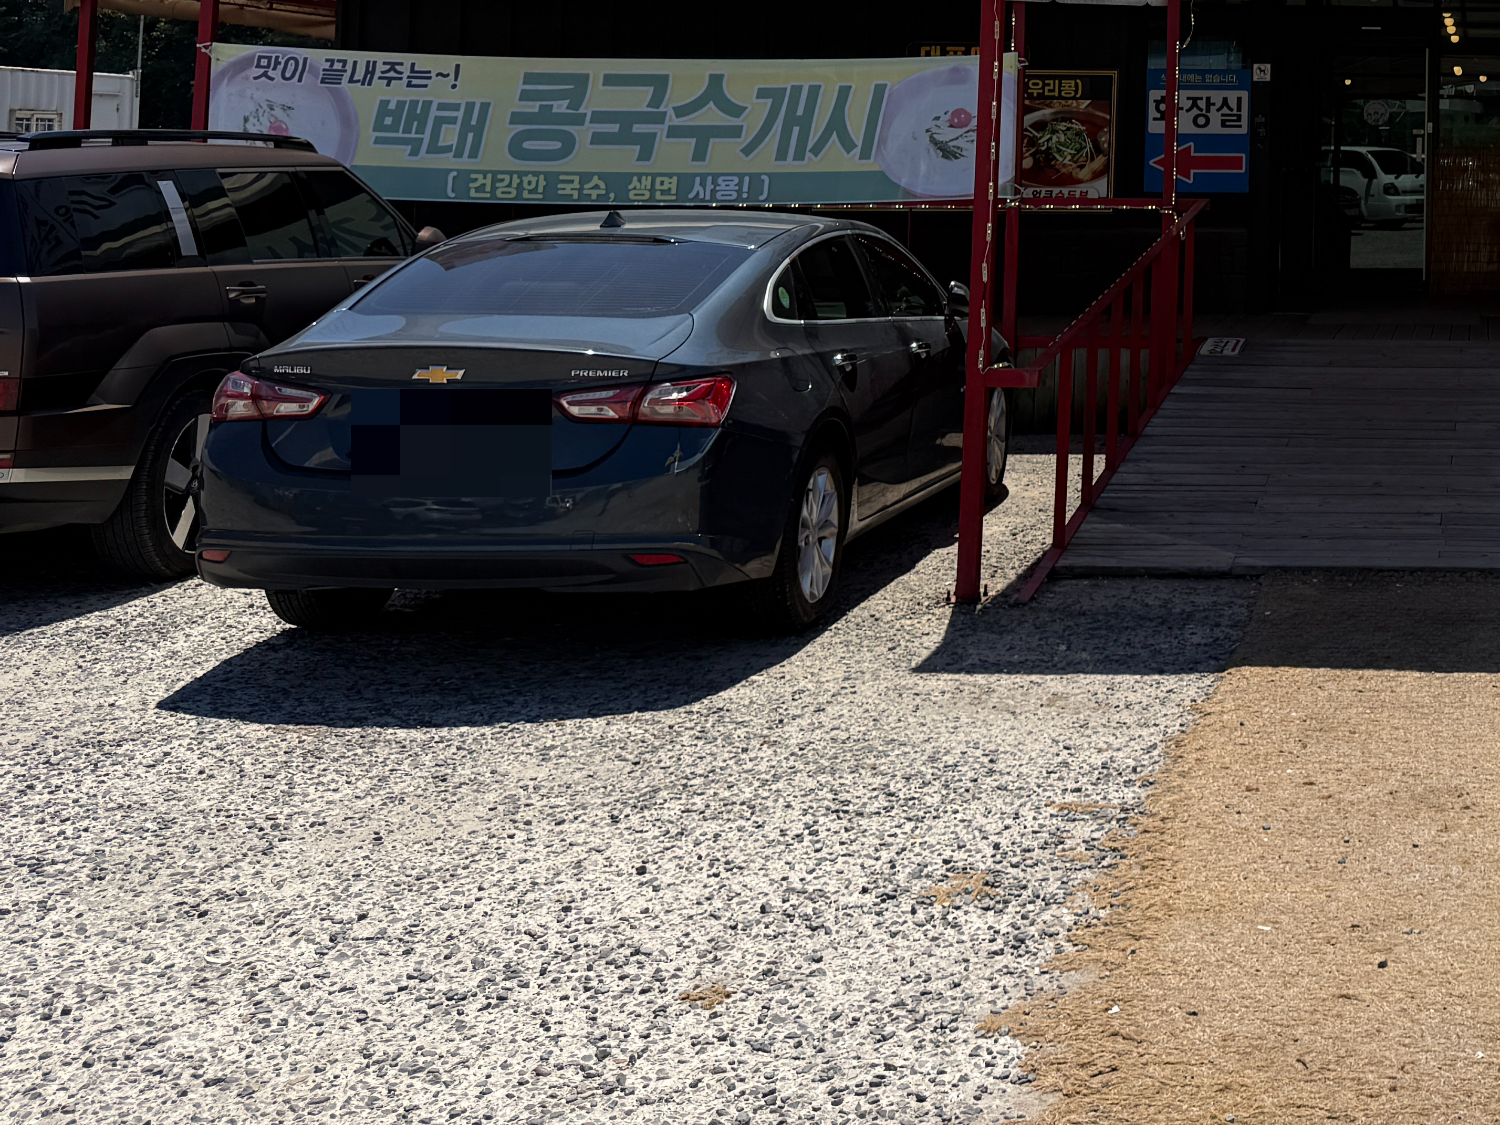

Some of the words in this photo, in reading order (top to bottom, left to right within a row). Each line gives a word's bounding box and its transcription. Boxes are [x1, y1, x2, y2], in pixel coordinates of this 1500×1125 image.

[252, 53, 309, 84] 맛이
[370, 95, 494, 163] 백태
[507, 70, 891, 166] 콩국수개시
[627, 175, 678, 201] 생면
[273, 365, 312, 374] MALIBU
[571, 369, 629, 377] PREMIER
